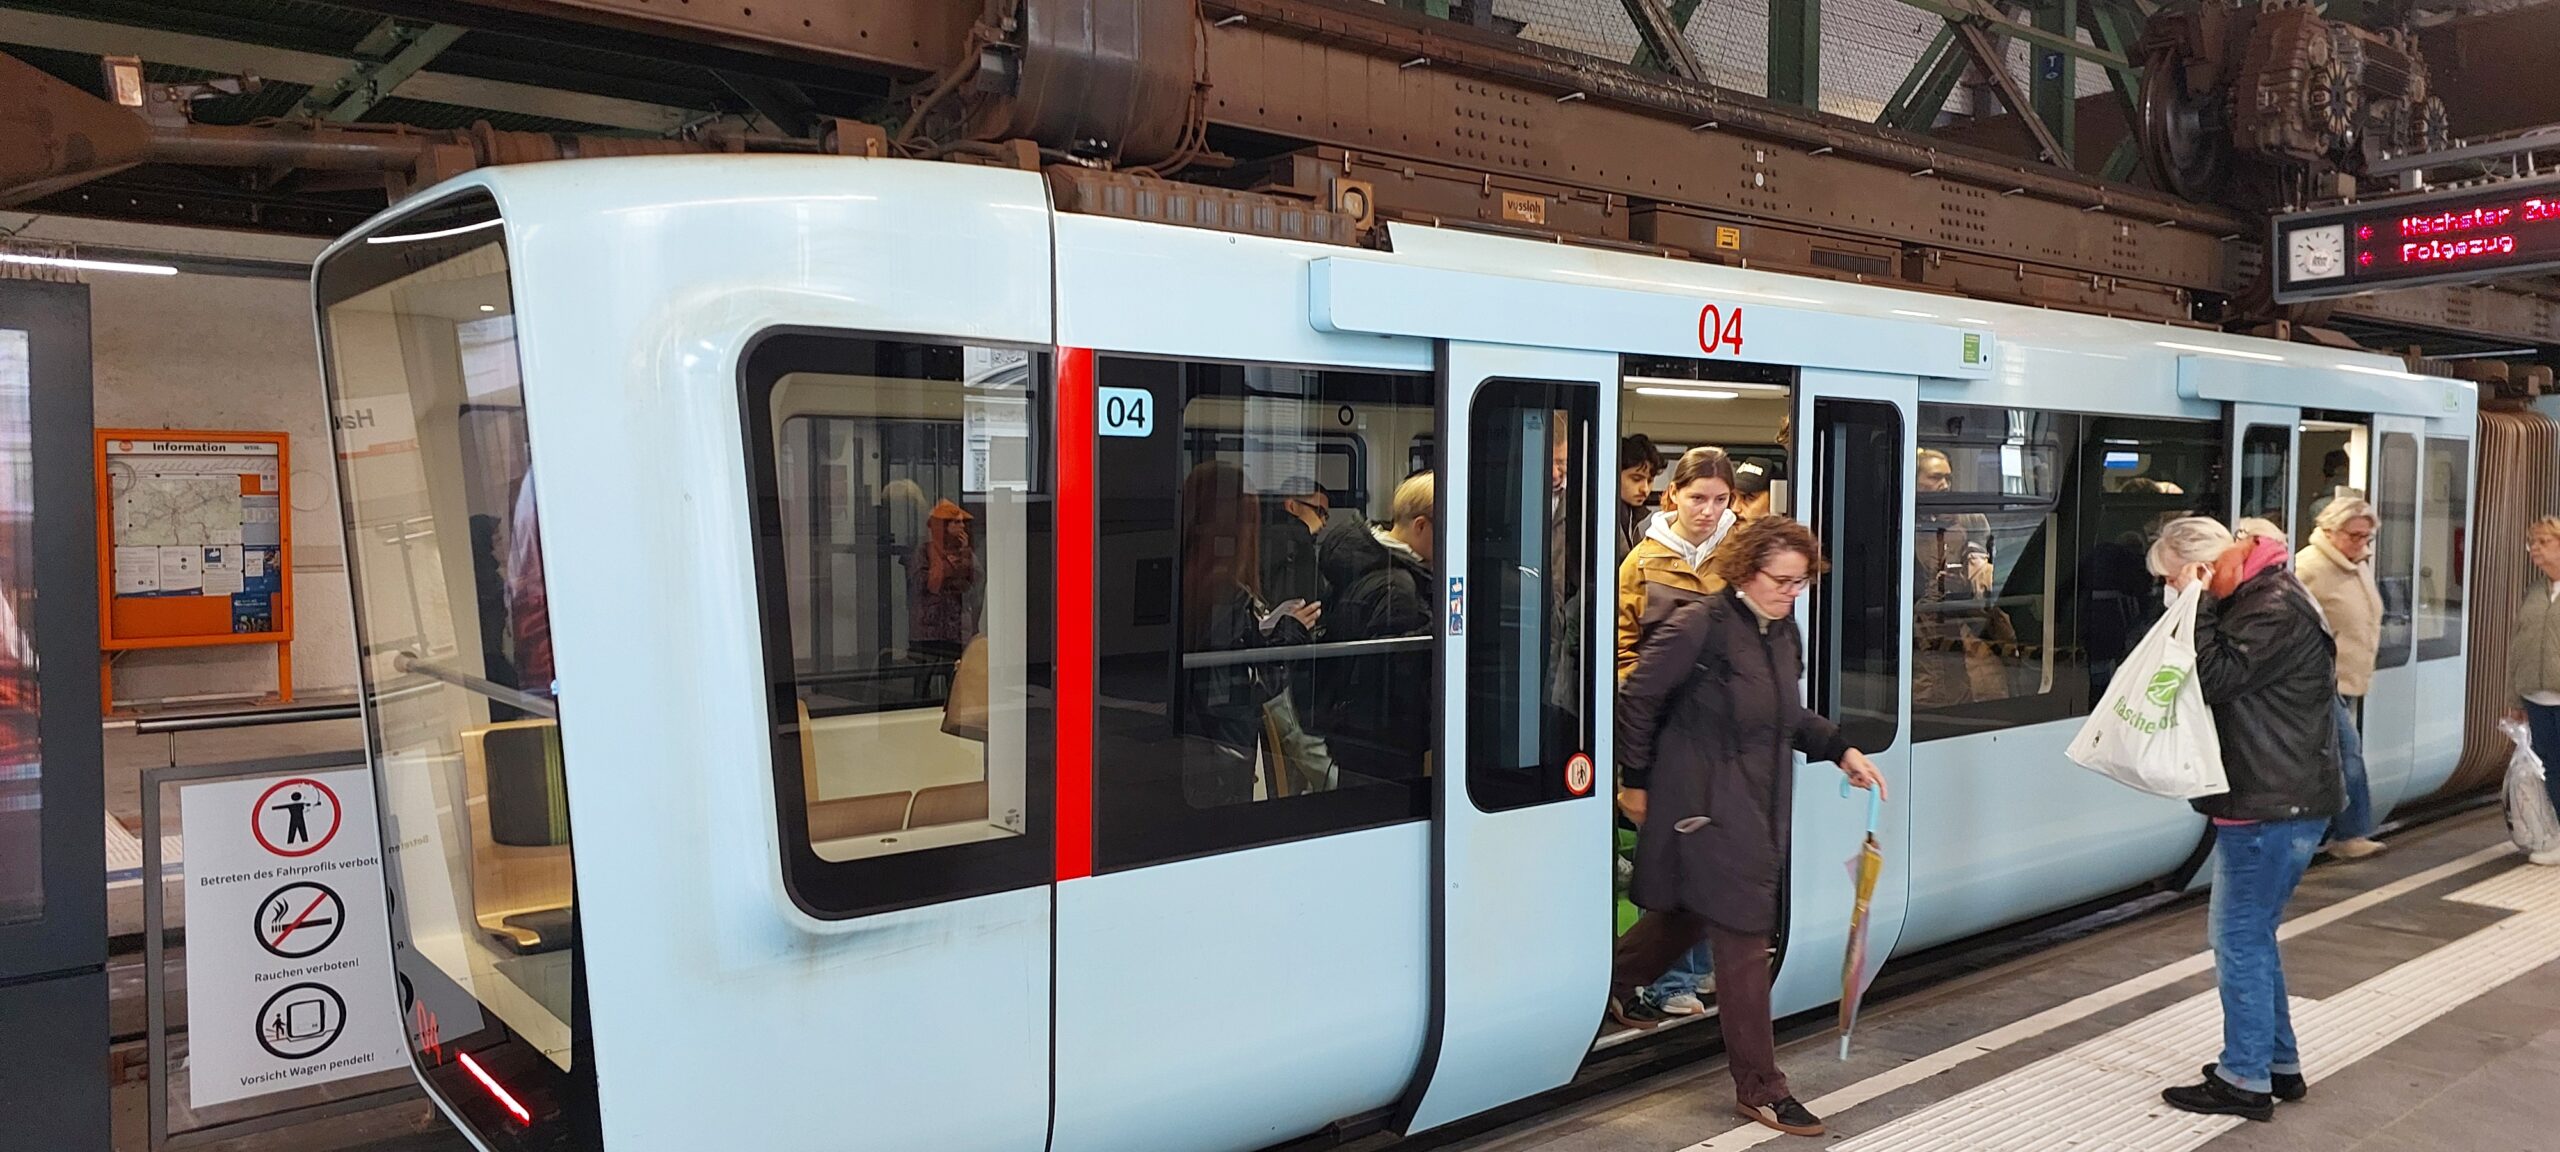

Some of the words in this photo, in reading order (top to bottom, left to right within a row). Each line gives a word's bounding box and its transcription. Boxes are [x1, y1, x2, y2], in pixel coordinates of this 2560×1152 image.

[2525, 199, 2560, 221] Zu
[2402, 236, 2513, 262] Folgezug
[1698, 303, 1743, 355] 04
[1106, 396, 1146, 429] 04
[152, 442, 226, 452] Information
[200, 872, 251, 887] Betreten
[253, 869, 274, 880] des
[276, 861, 337, 878] Fahrprofils
[254, 967, 304, 983] Rauchen
[306, 957, 359, 975] verboten!
[240, 1068, 287, 1087] Vorsicht
[289, 1061, 327, 1077] Wagen
[329, 1053, 375, 1072] pendelt!
